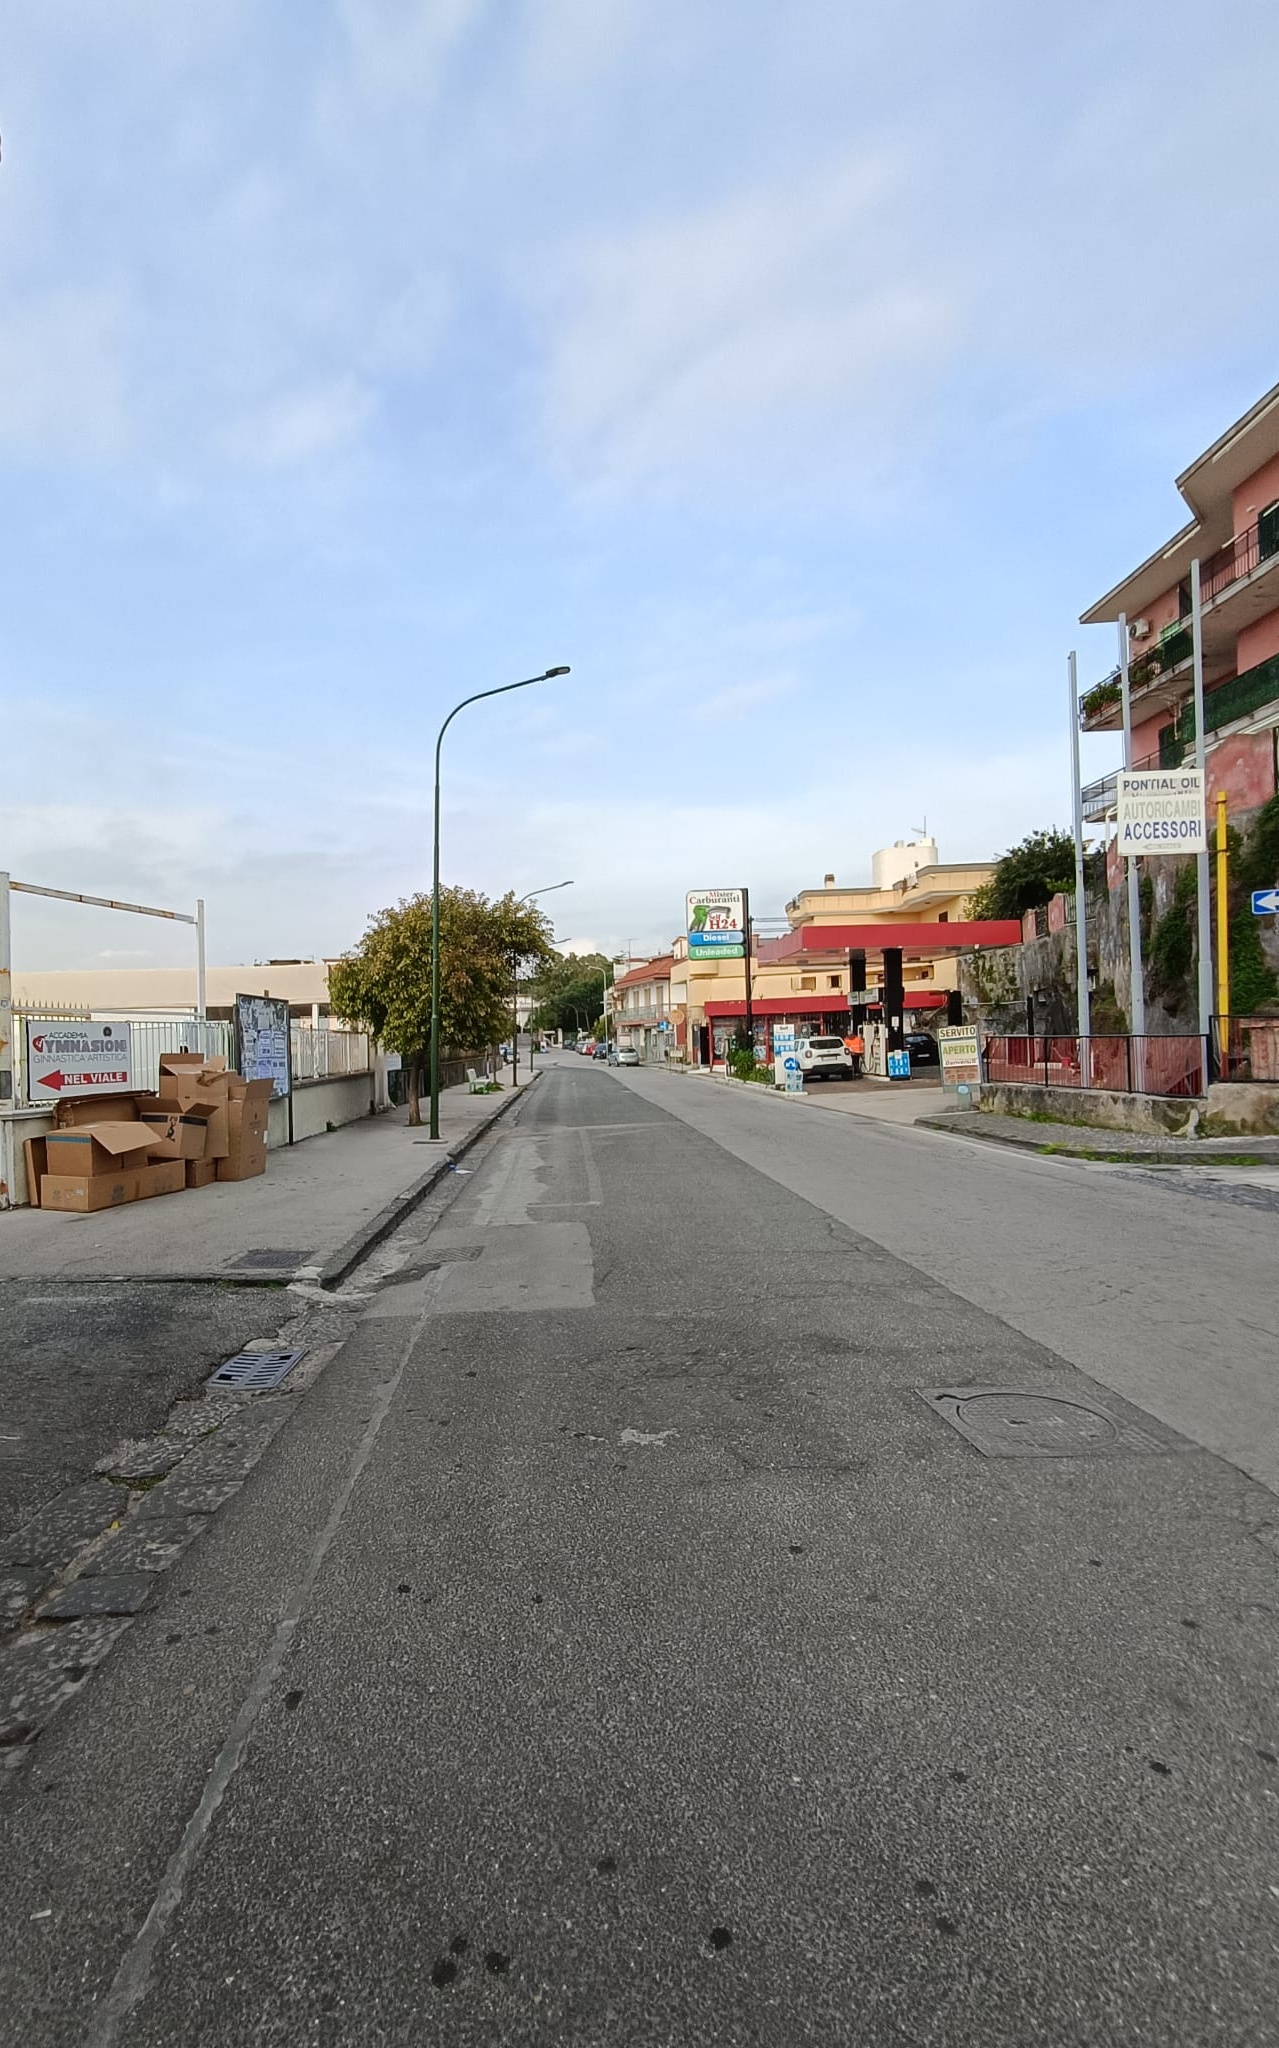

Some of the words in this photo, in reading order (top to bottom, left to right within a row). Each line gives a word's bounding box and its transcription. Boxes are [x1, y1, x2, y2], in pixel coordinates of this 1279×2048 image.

[1181, 777, 1200, 788] OIL
[1123, 800, 1201, 820] AUTORICAMBI
[1124, 820, 1202, 840] ACCESSORI
[689, 894, 740, 904] Carburanti
[709, 919, 737, 929] H24
[695, 947, 738, 957] Unleaded
[49, 1031, 88, 1039] ACCADEMIA
[940, 1026, 976, 1038] SERVITO
[943, 1045, 976, 1054] APERTO
[33, 1054, 86, 1064] GINNASTICA
[86, 1053, 127, 1063] ARTISTICA
[64, 1074, 88, 1085] NEL
[90, 1072, 123, 1083] VIALE
